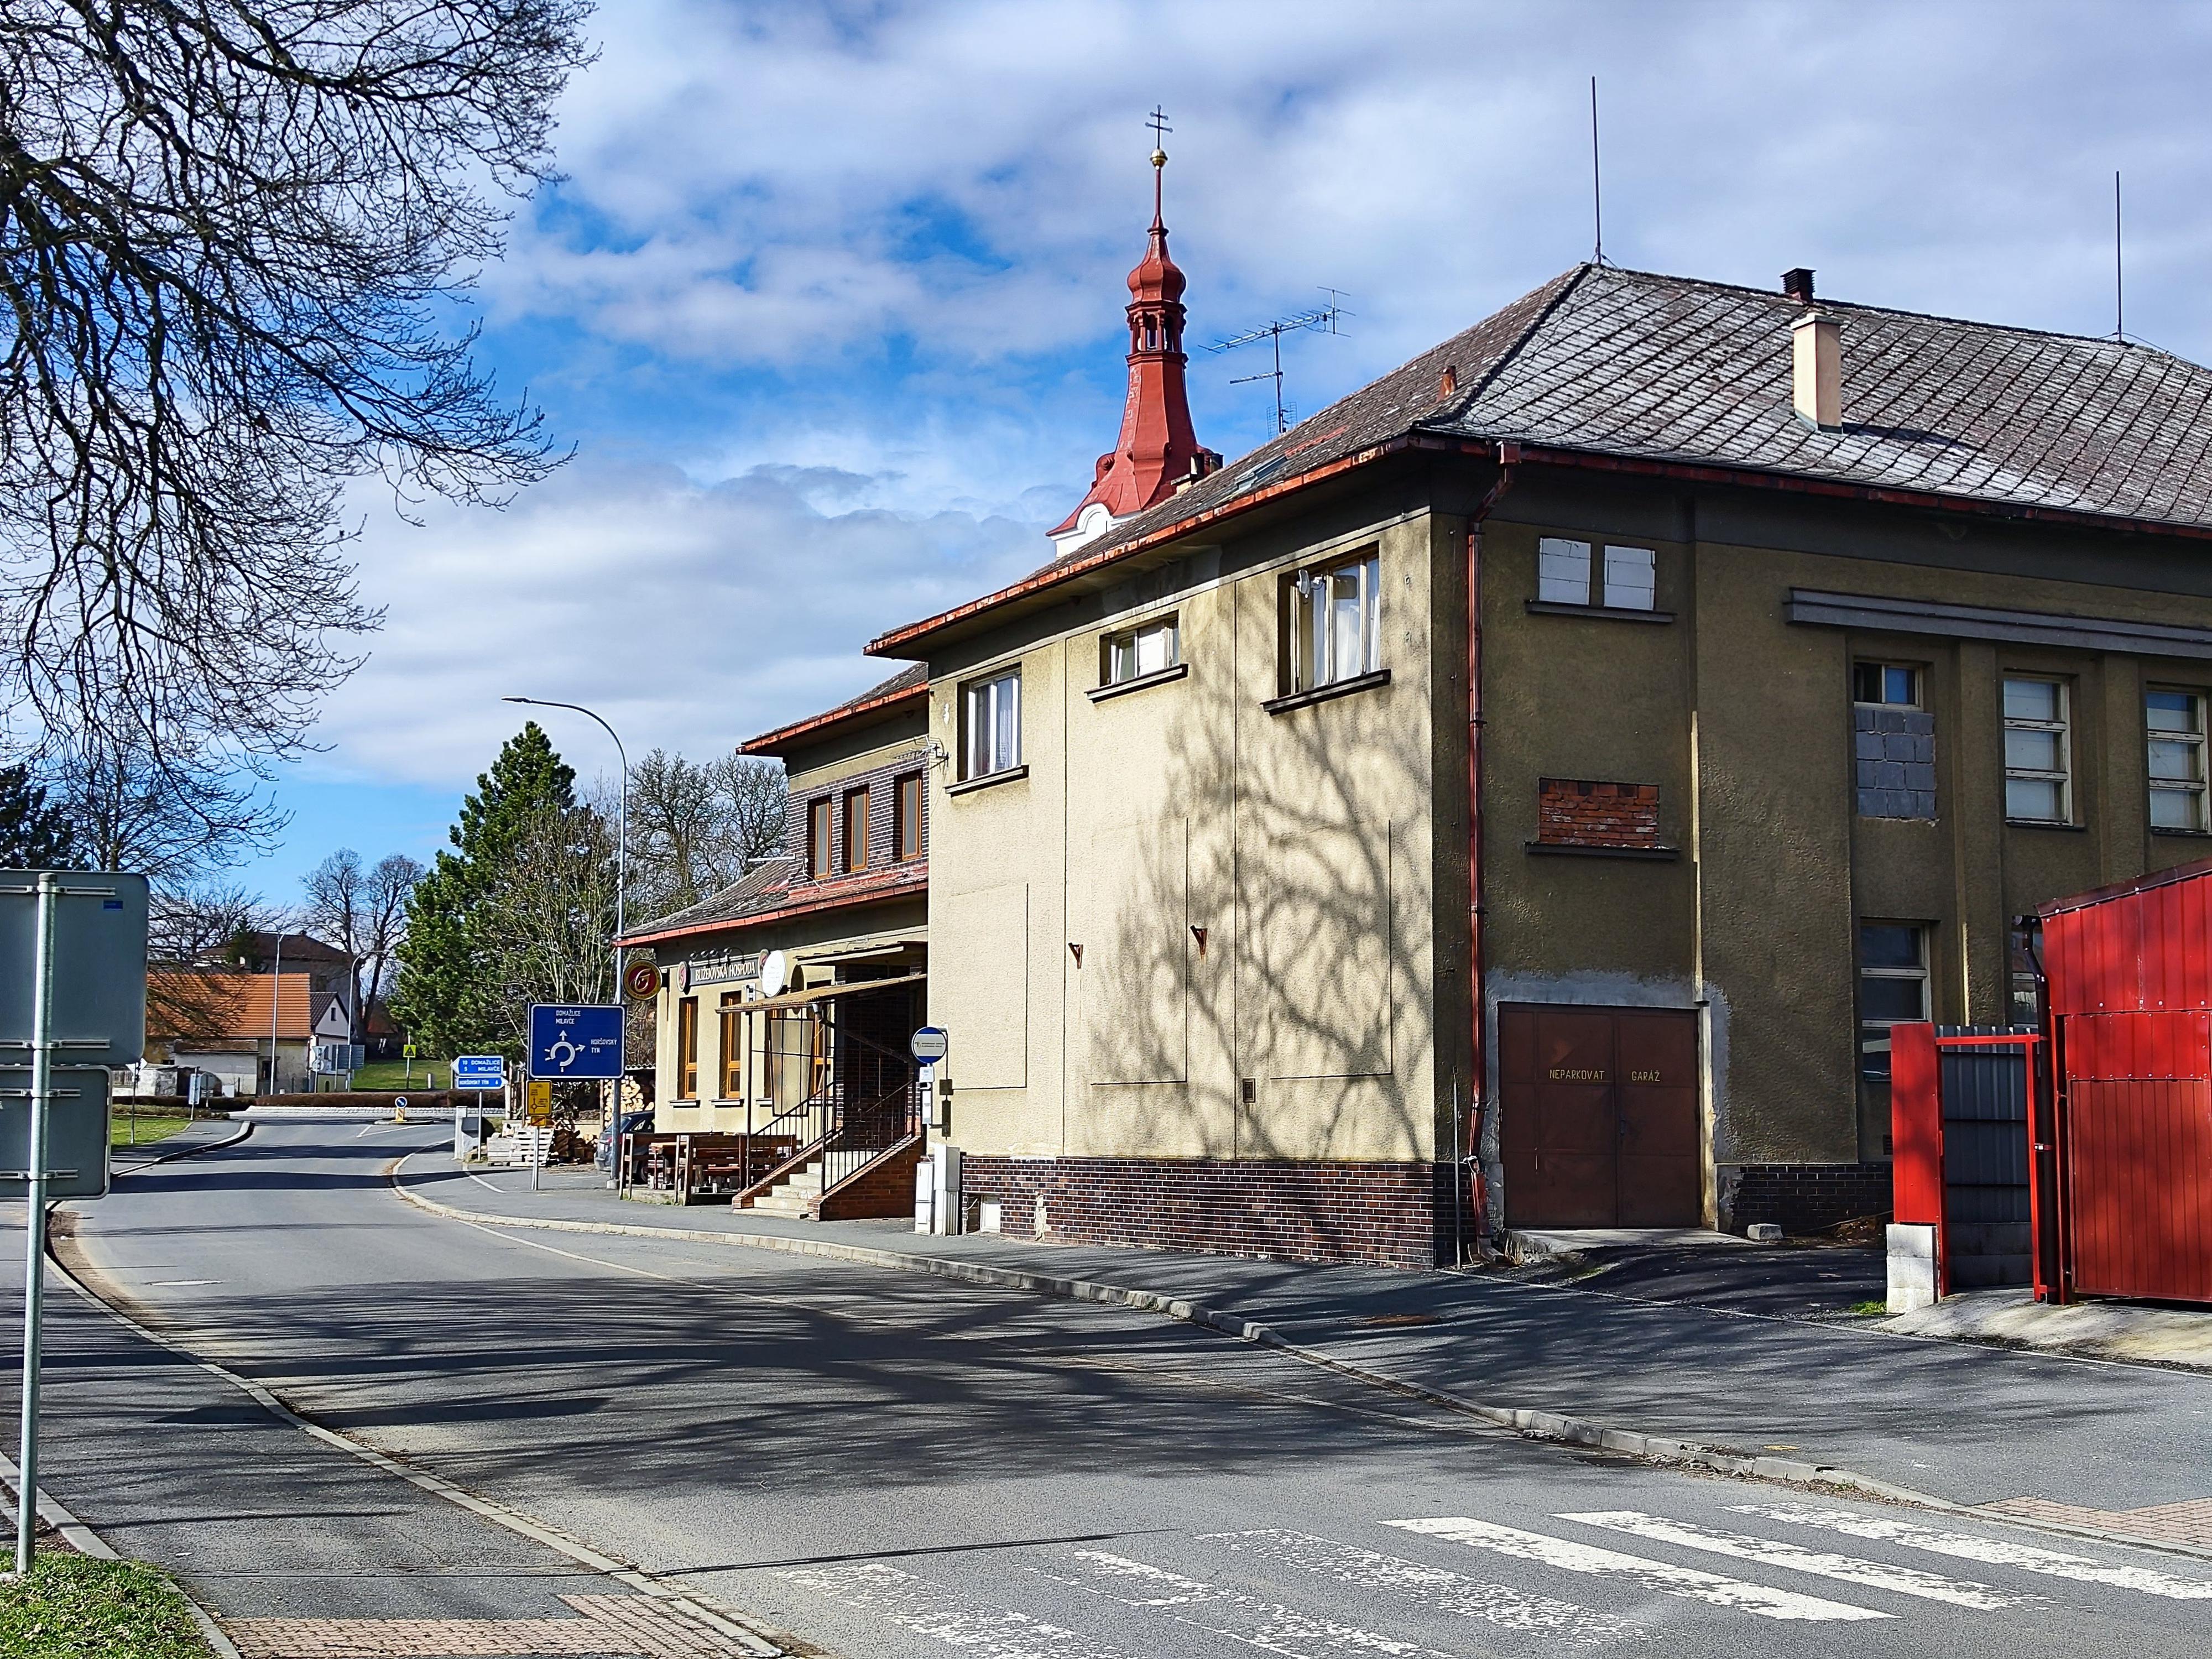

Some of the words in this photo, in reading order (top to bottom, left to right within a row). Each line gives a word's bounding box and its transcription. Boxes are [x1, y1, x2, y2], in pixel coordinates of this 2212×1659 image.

[695, 963, 728, 981] BLIŽEJOVSKÁ
[729, 961, 755, 977] HOSPODA
[1550, 1070, 1605, 1080] NEPARKOVAT
[1631, 1070, 1660, 1082] GARÁŽ
